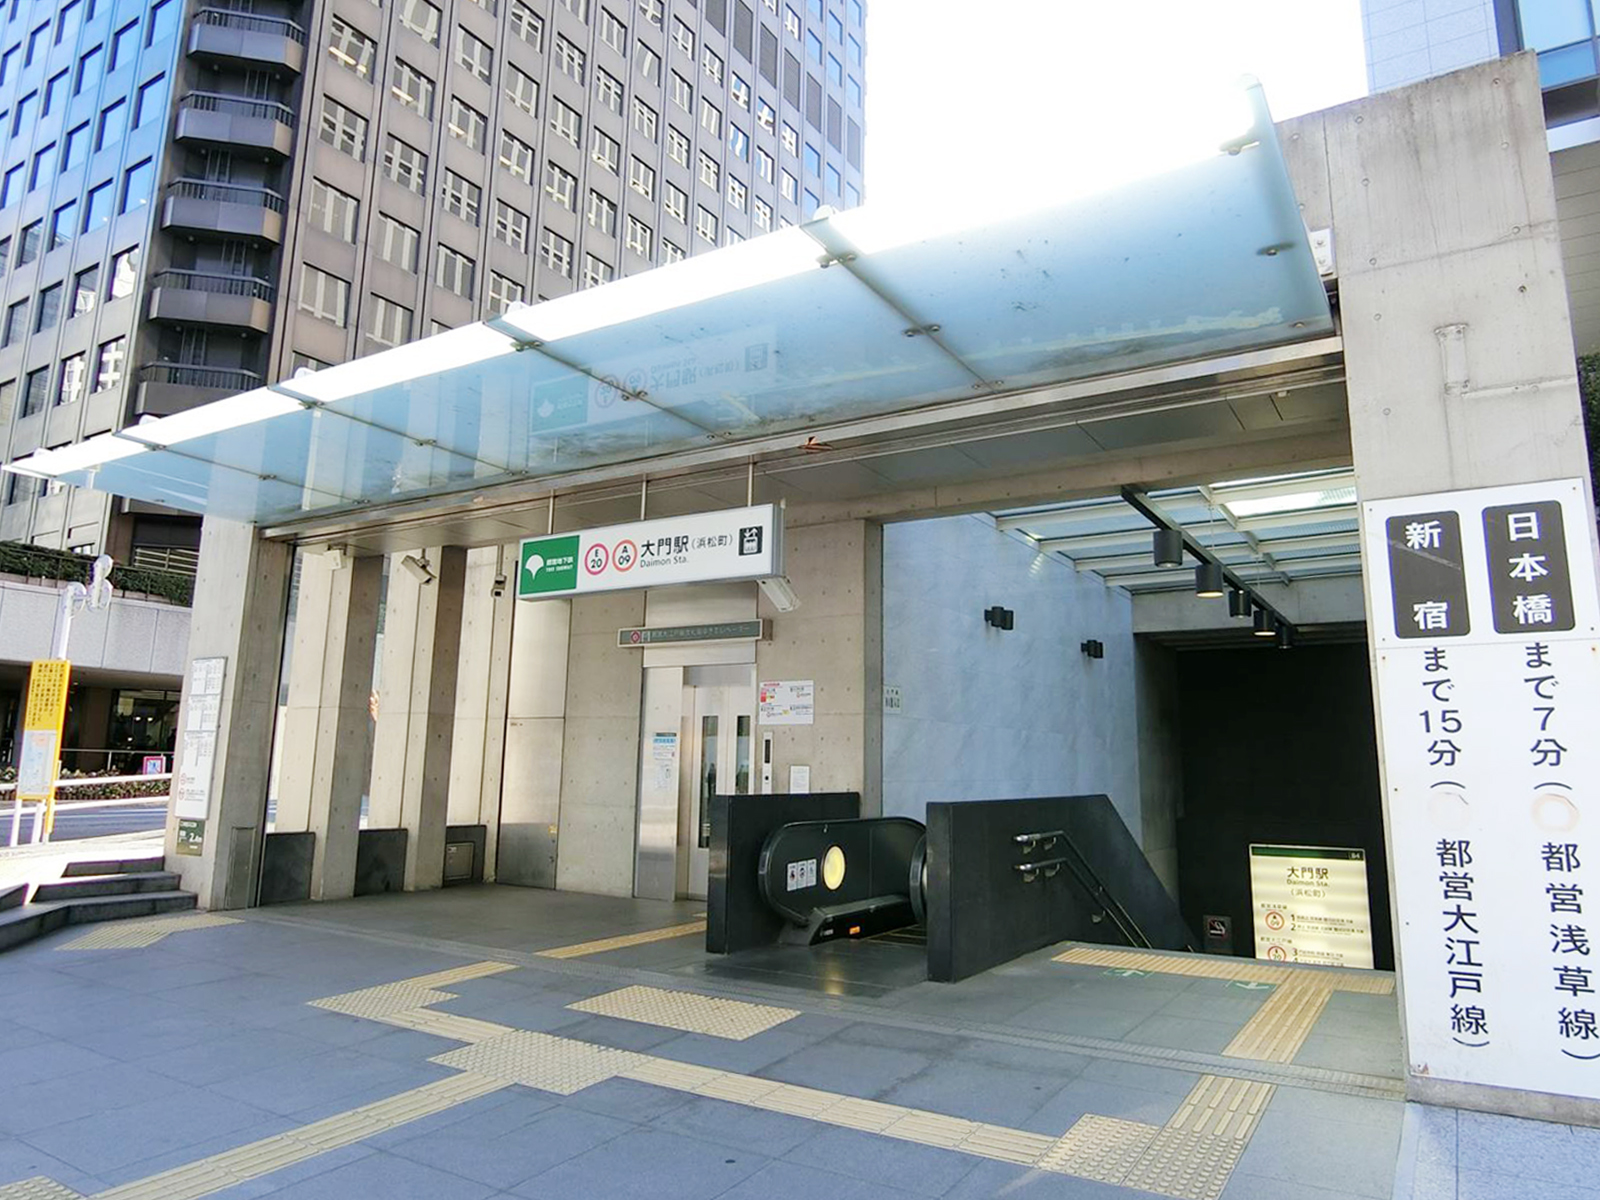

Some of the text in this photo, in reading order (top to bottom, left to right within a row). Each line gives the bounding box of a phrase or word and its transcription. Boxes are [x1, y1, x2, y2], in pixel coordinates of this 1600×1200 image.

[594, 549, 600, 558] E
[621, 545, 629, 554] A
[590, 558, 603, 569] 20
[617, 554, 632, 566] 09
[640, 555, 689, 568] Daimon Sta.
[1506, 511, 1553, 625] 日本橋
[1404, 520, 1449, 630] 新宿
[1286, 866, 1329, 880] 大門駅
[1286, 879, 1315, 887] Daimon
